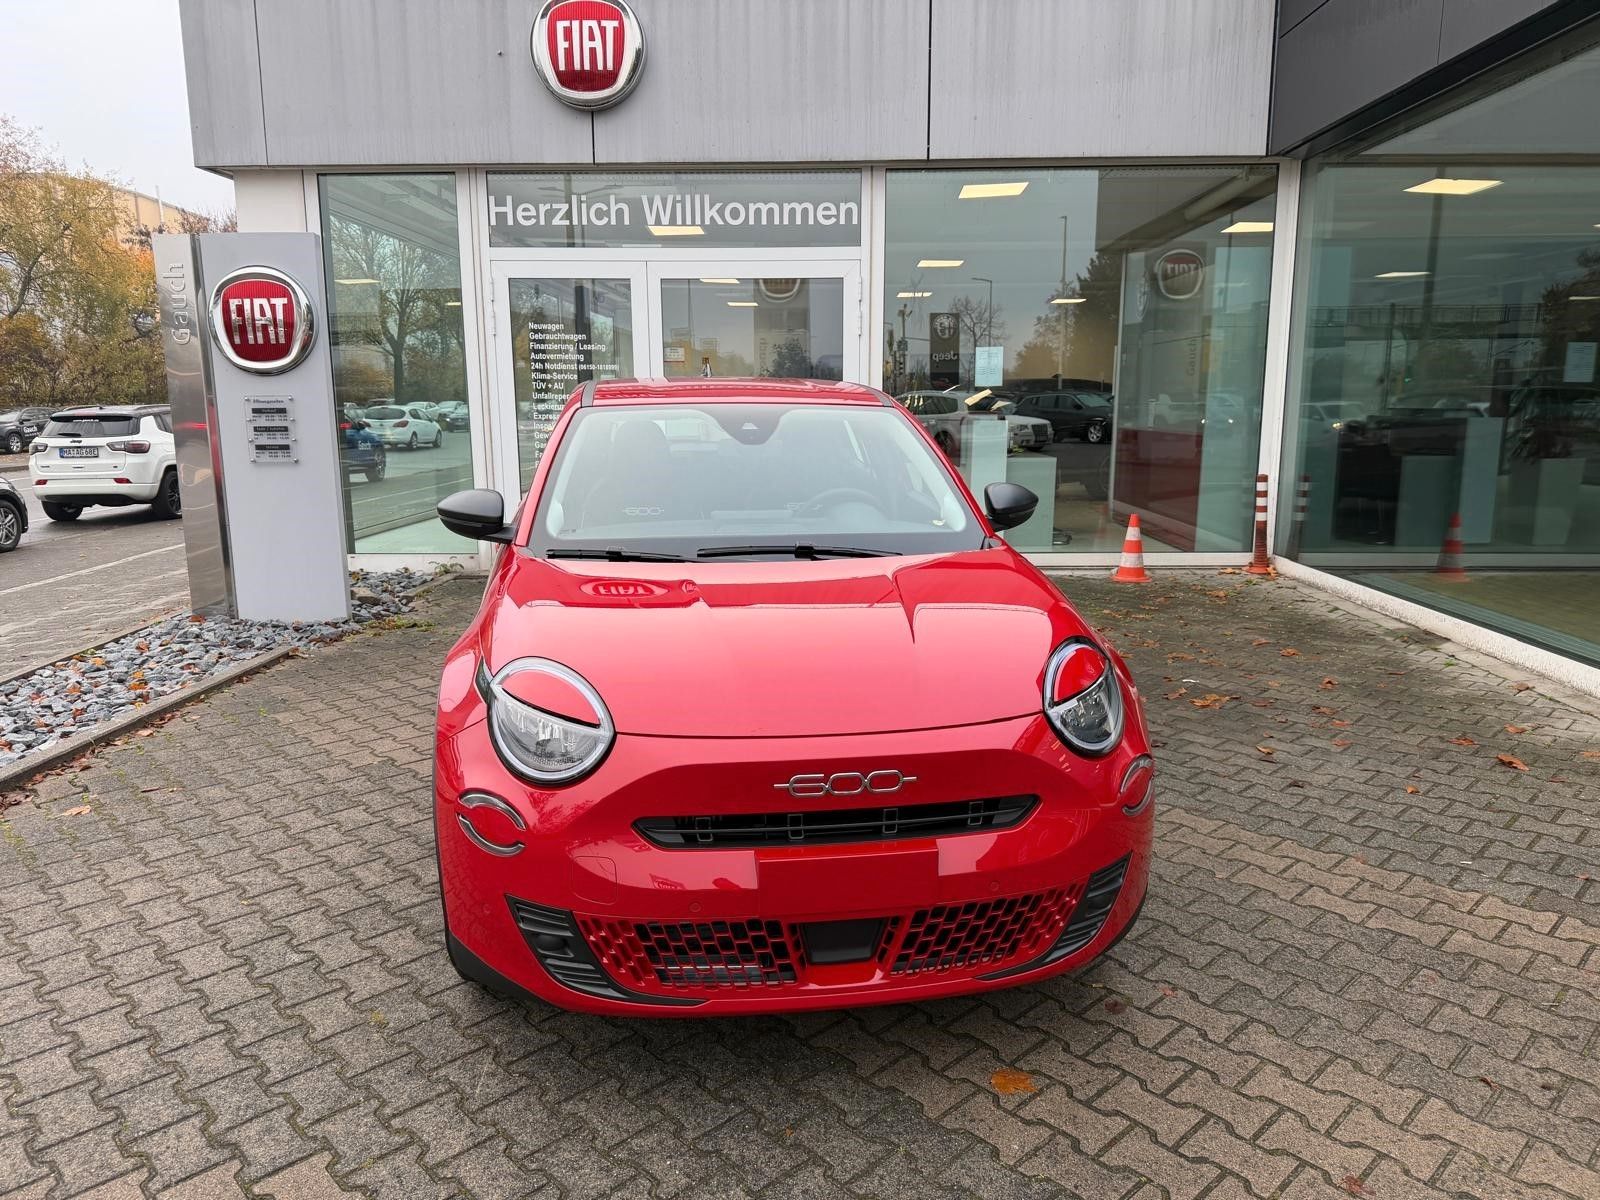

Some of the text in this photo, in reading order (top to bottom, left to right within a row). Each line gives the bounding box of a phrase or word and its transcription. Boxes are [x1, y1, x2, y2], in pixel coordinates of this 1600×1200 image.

[556, 20, 619, 70] FIAT
[488, 194, 858, 226] Herzlich Willkommen
[162, 264, 190, 346] Gauch
[228, 298, 288, 344] FIAT
[528, 322, 564, 331] Neuwagen
[529, 332, 586, 341] Gebrauchtwagen
[529, 342, 573, 351] Finanzierung
[580, 343, 606, 352] Leasing
[530, 352, 584, 361] Autovermietung
[532, 380, 546, 389] TÜV
[786, 770, 906, 798] 600
